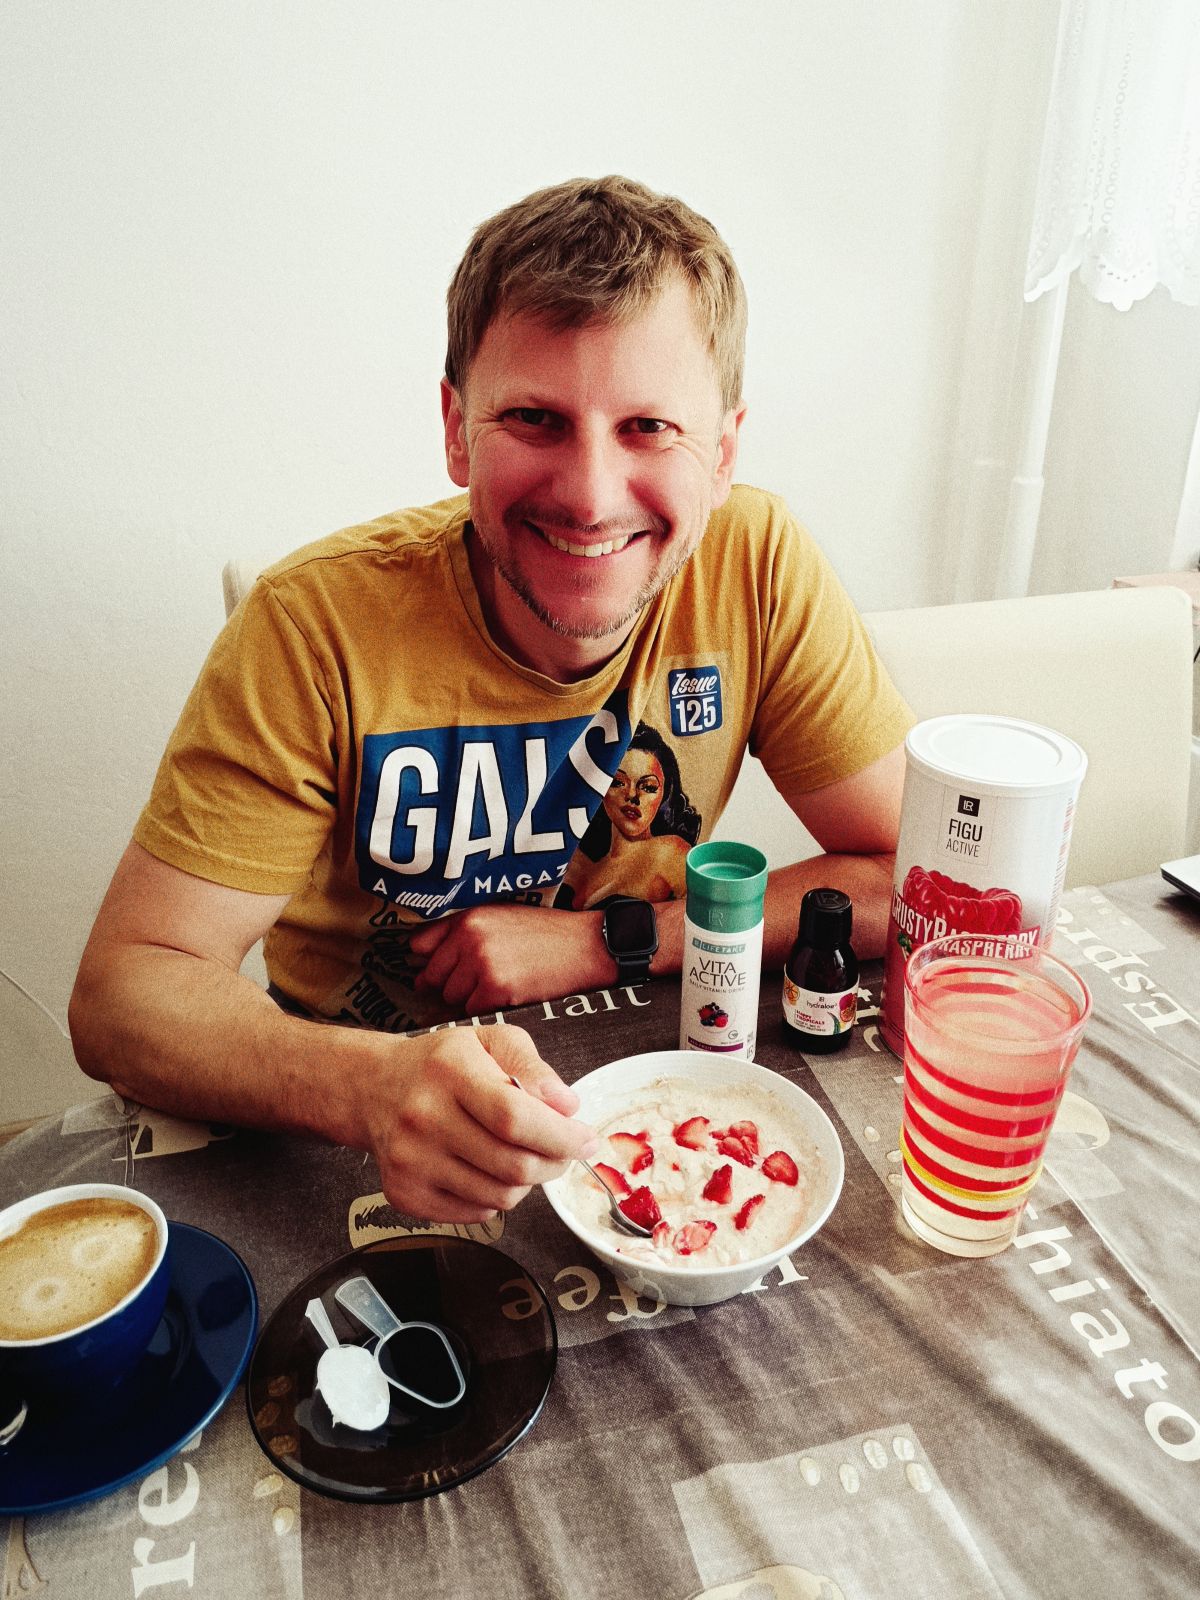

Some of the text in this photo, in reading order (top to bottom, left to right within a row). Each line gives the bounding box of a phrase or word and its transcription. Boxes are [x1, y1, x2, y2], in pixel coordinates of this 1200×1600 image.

[672, 672, 717, 695] Issue
[676, 696, 716, 732] 125
[369, 709, 620, 880] GALS
[949, 818, 983, 842] FIGU
[946, 838, 981, 857] ACTIVE
[372, 878, 388, 895] A
[689, 966, 747, 987] ACTIVE
[699, 957, 737, 974] VITA
[1013, 1203, 1200, 1461] hiato
